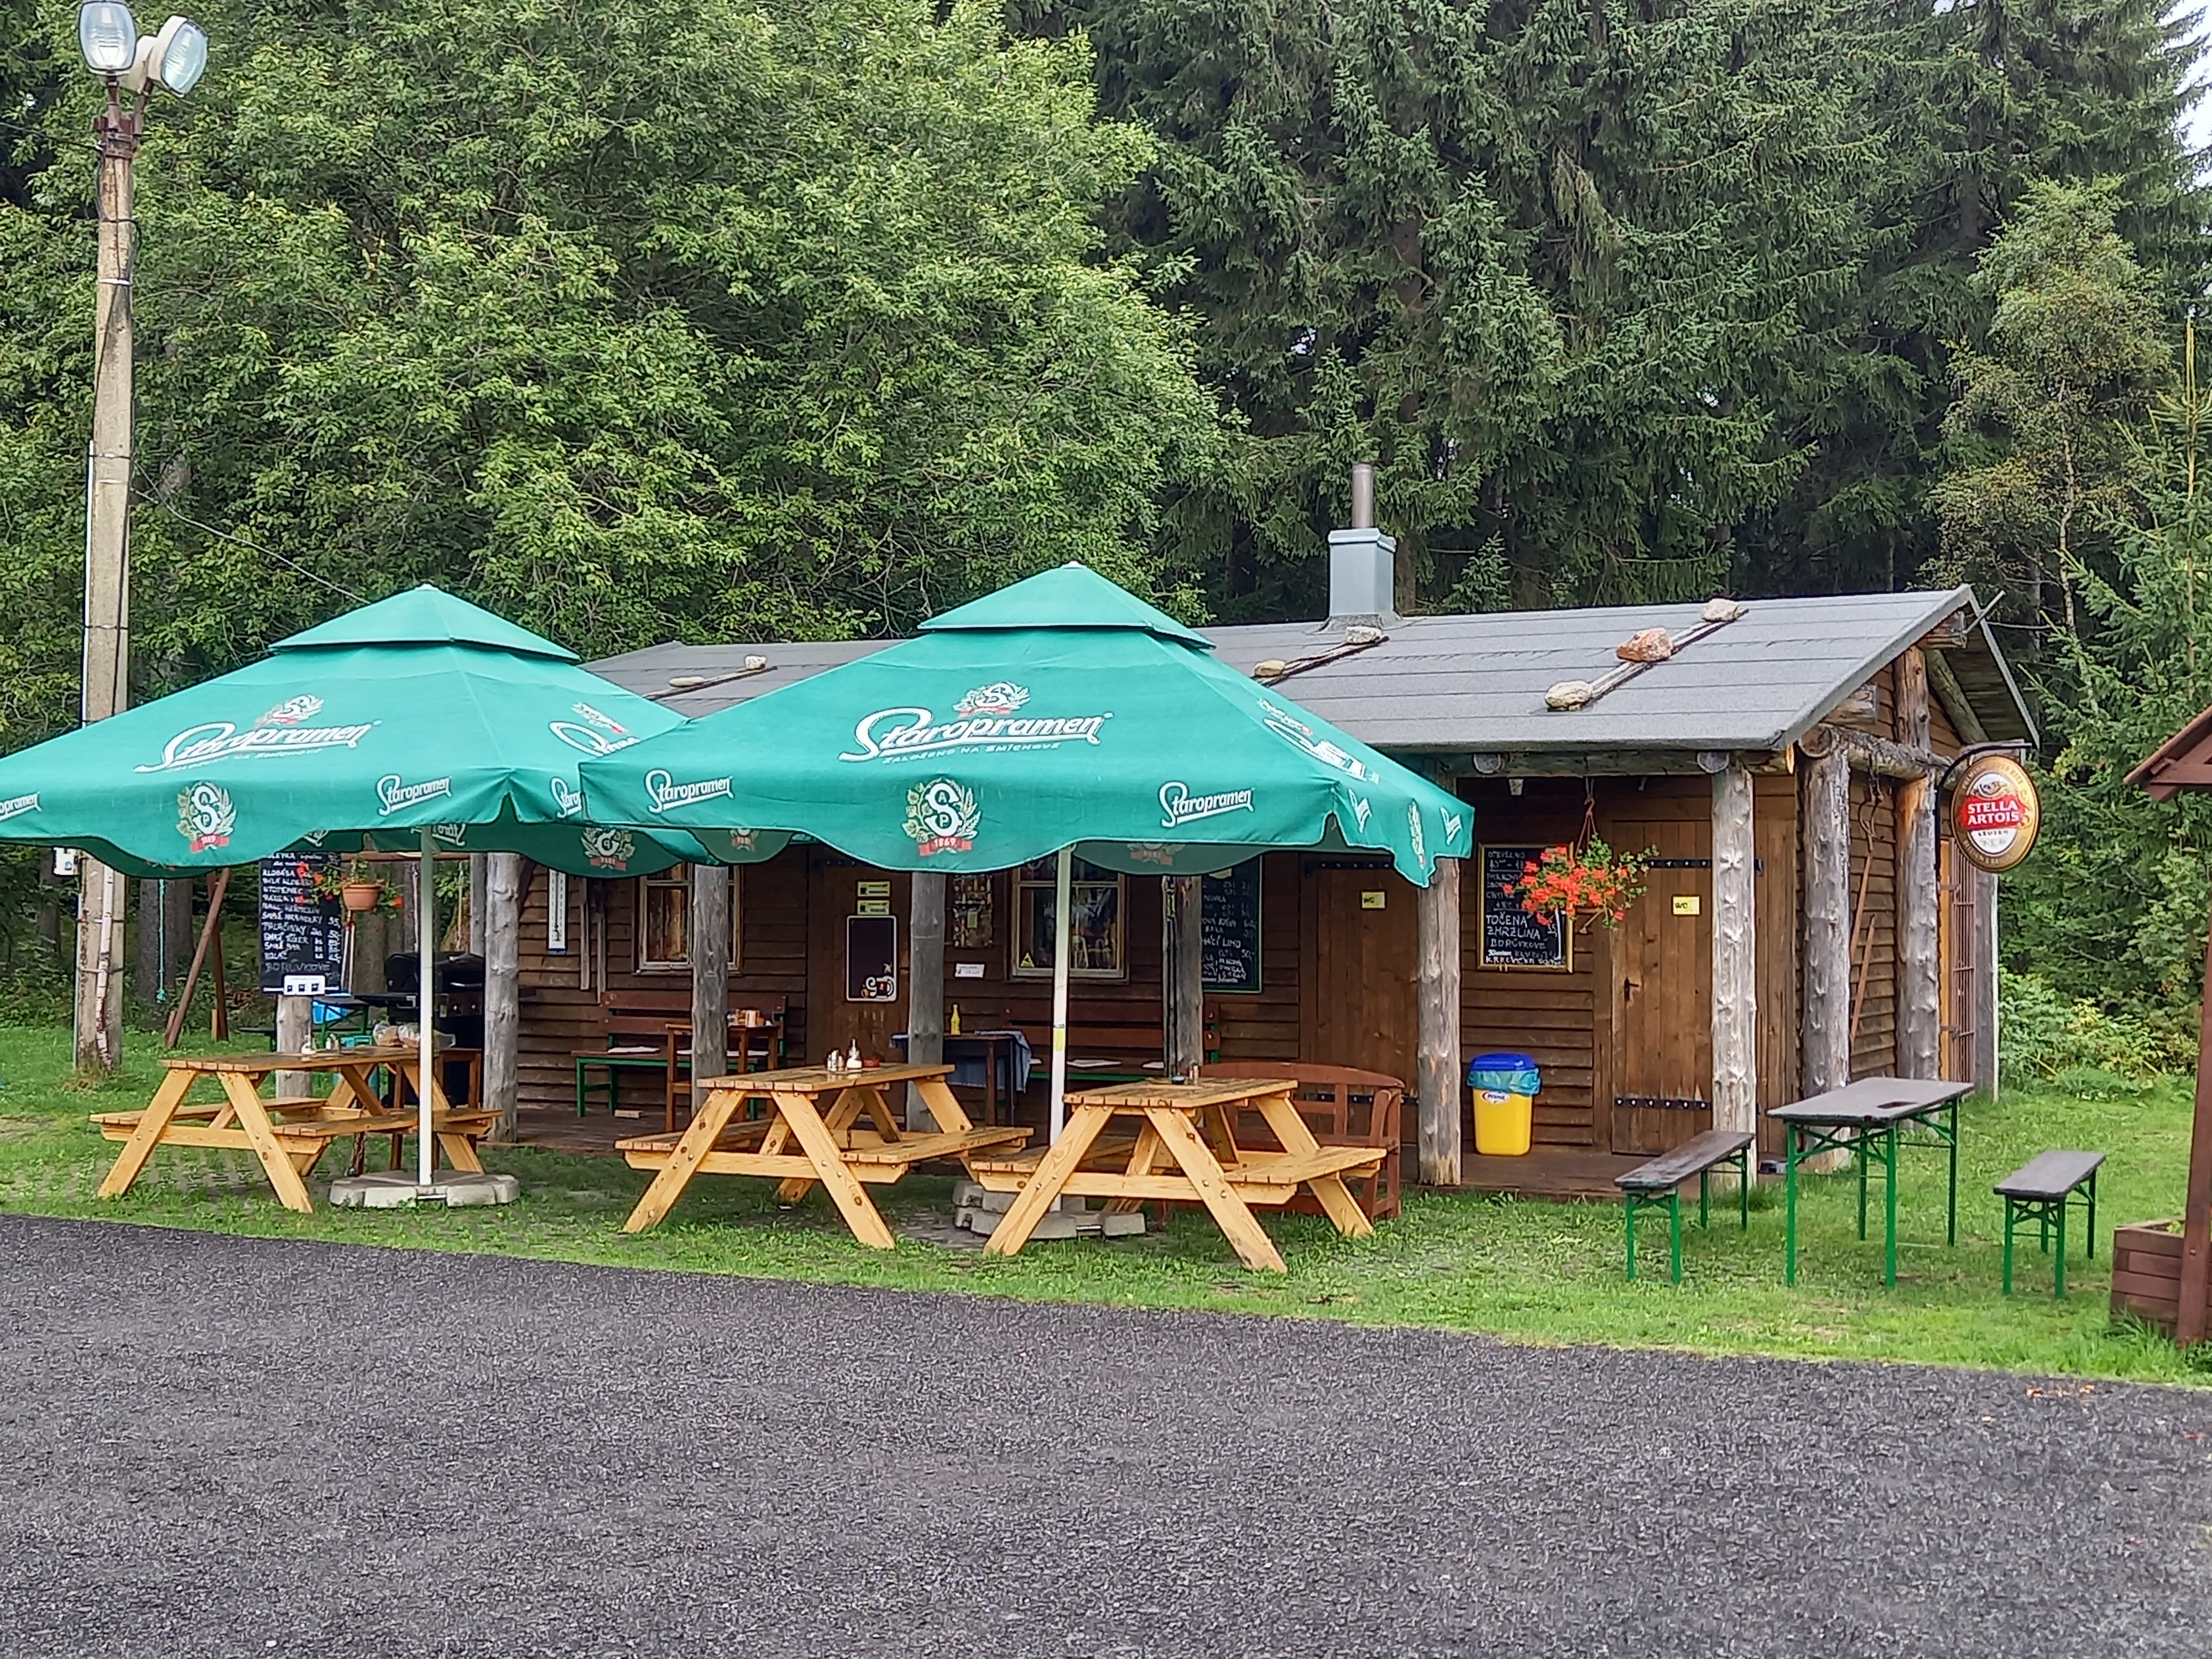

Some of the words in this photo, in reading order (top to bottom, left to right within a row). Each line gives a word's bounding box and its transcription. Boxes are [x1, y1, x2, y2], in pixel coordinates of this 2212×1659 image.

[133, 721, 373, 773] Staropramen
[838, 707, 1103, 762] Staropramen
[377, 774, 452, 816] Staropramen
[645, 769, 733, 813] Staropramen
[1159, 781, 1254, 828] Staropramen
[1967, 800, 2018, 814] STELLA
[1967, 811, 2020, 826] ARTOIS
[933, 837, 957, 848] 1869
[1486, 911, 1534, 928] TOČENÁ
